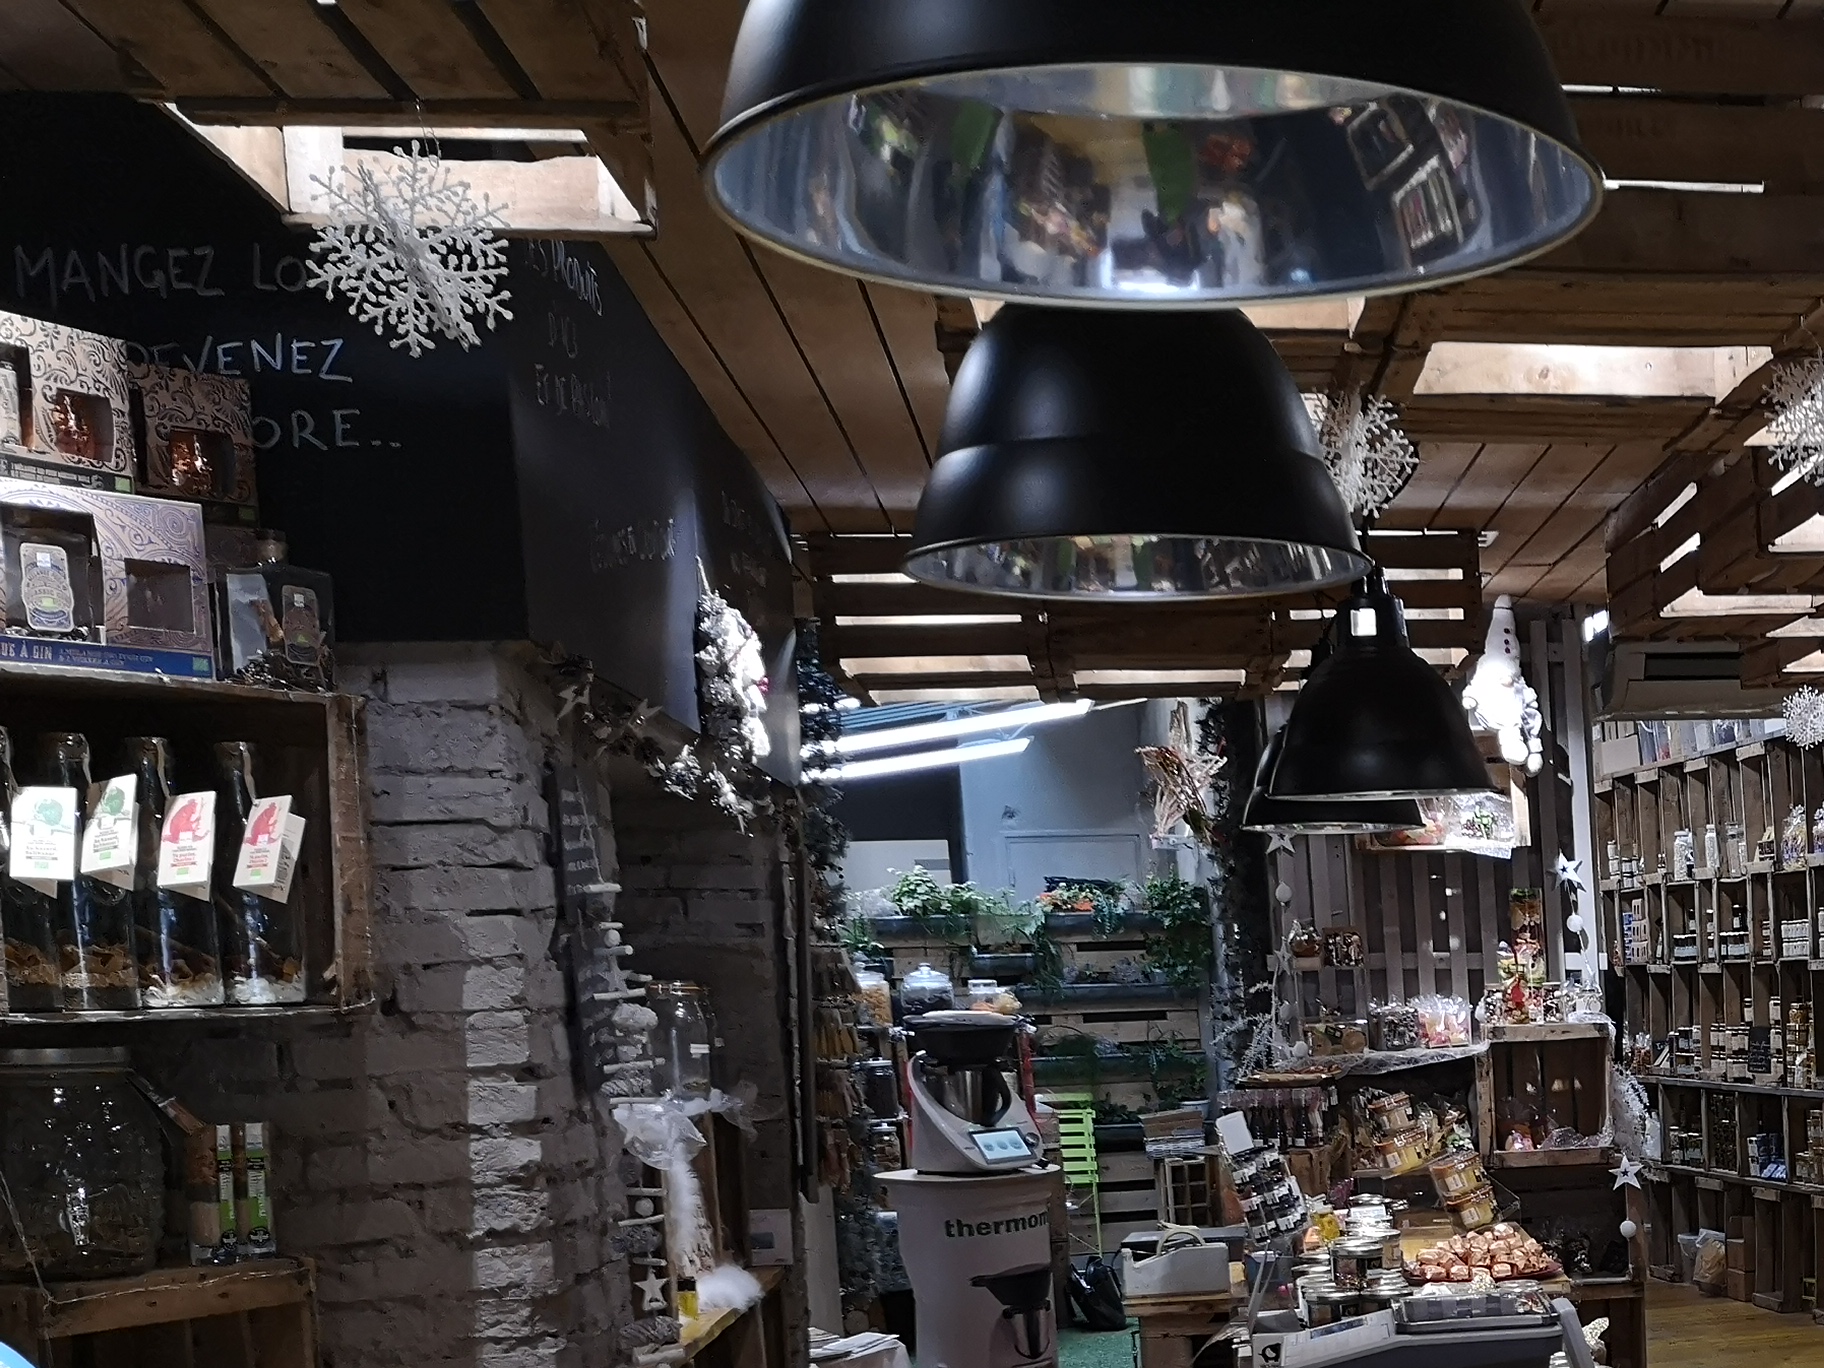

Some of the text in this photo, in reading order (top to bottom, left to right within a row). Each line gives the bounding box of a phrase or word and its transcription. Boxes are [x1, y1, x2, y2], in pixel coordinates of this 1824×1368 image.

[13, 242, 226, 310] MANGEZ
[250, 405, 403, 455] ORE..
[32, 645, 53, 660] GIN
